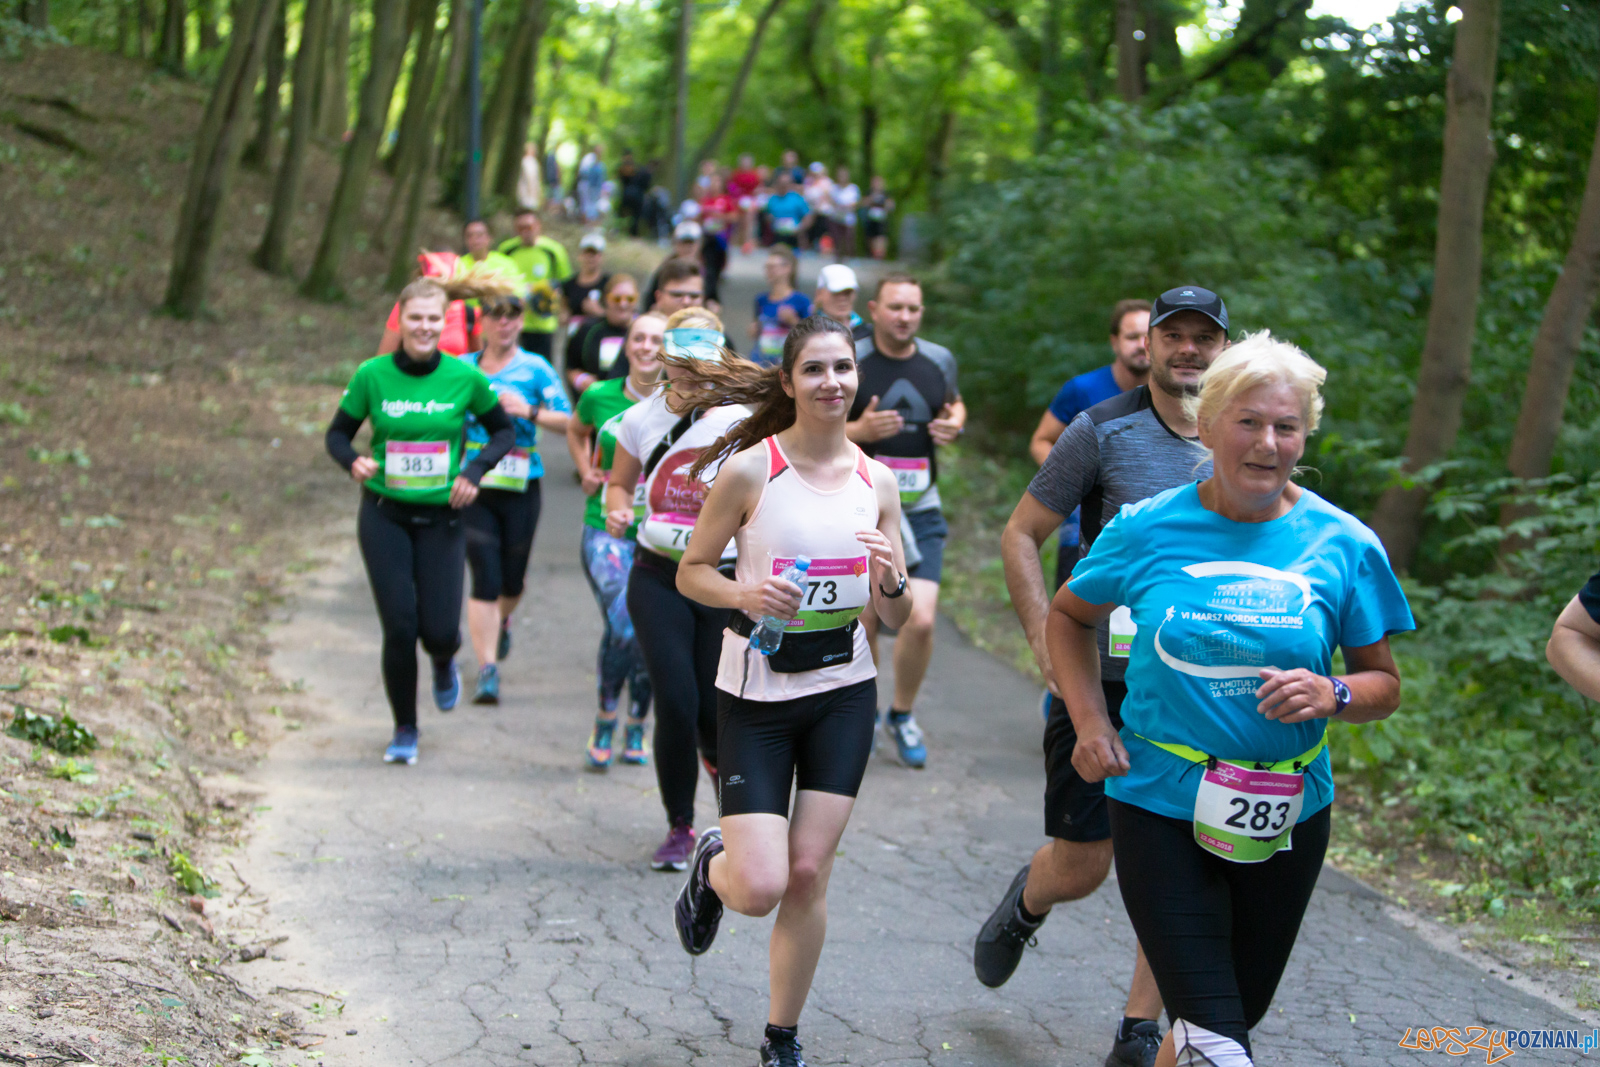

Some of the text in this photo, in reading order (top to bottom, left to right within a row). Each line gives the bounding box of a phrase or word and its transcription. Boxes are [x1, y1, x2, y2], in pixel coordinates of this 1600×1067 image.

[401, 457, 433, 472] 383
[807, 580, 838, 605] 73
[1181, 611, 1303, 625] VI MARSZ NORDIC WALKING
[1209, 680, 1257, 690] SZAMOTUŁY
[1211, 687, 1257, 697] 16.10.2016
[1224, 797, 1290, 831] 283
